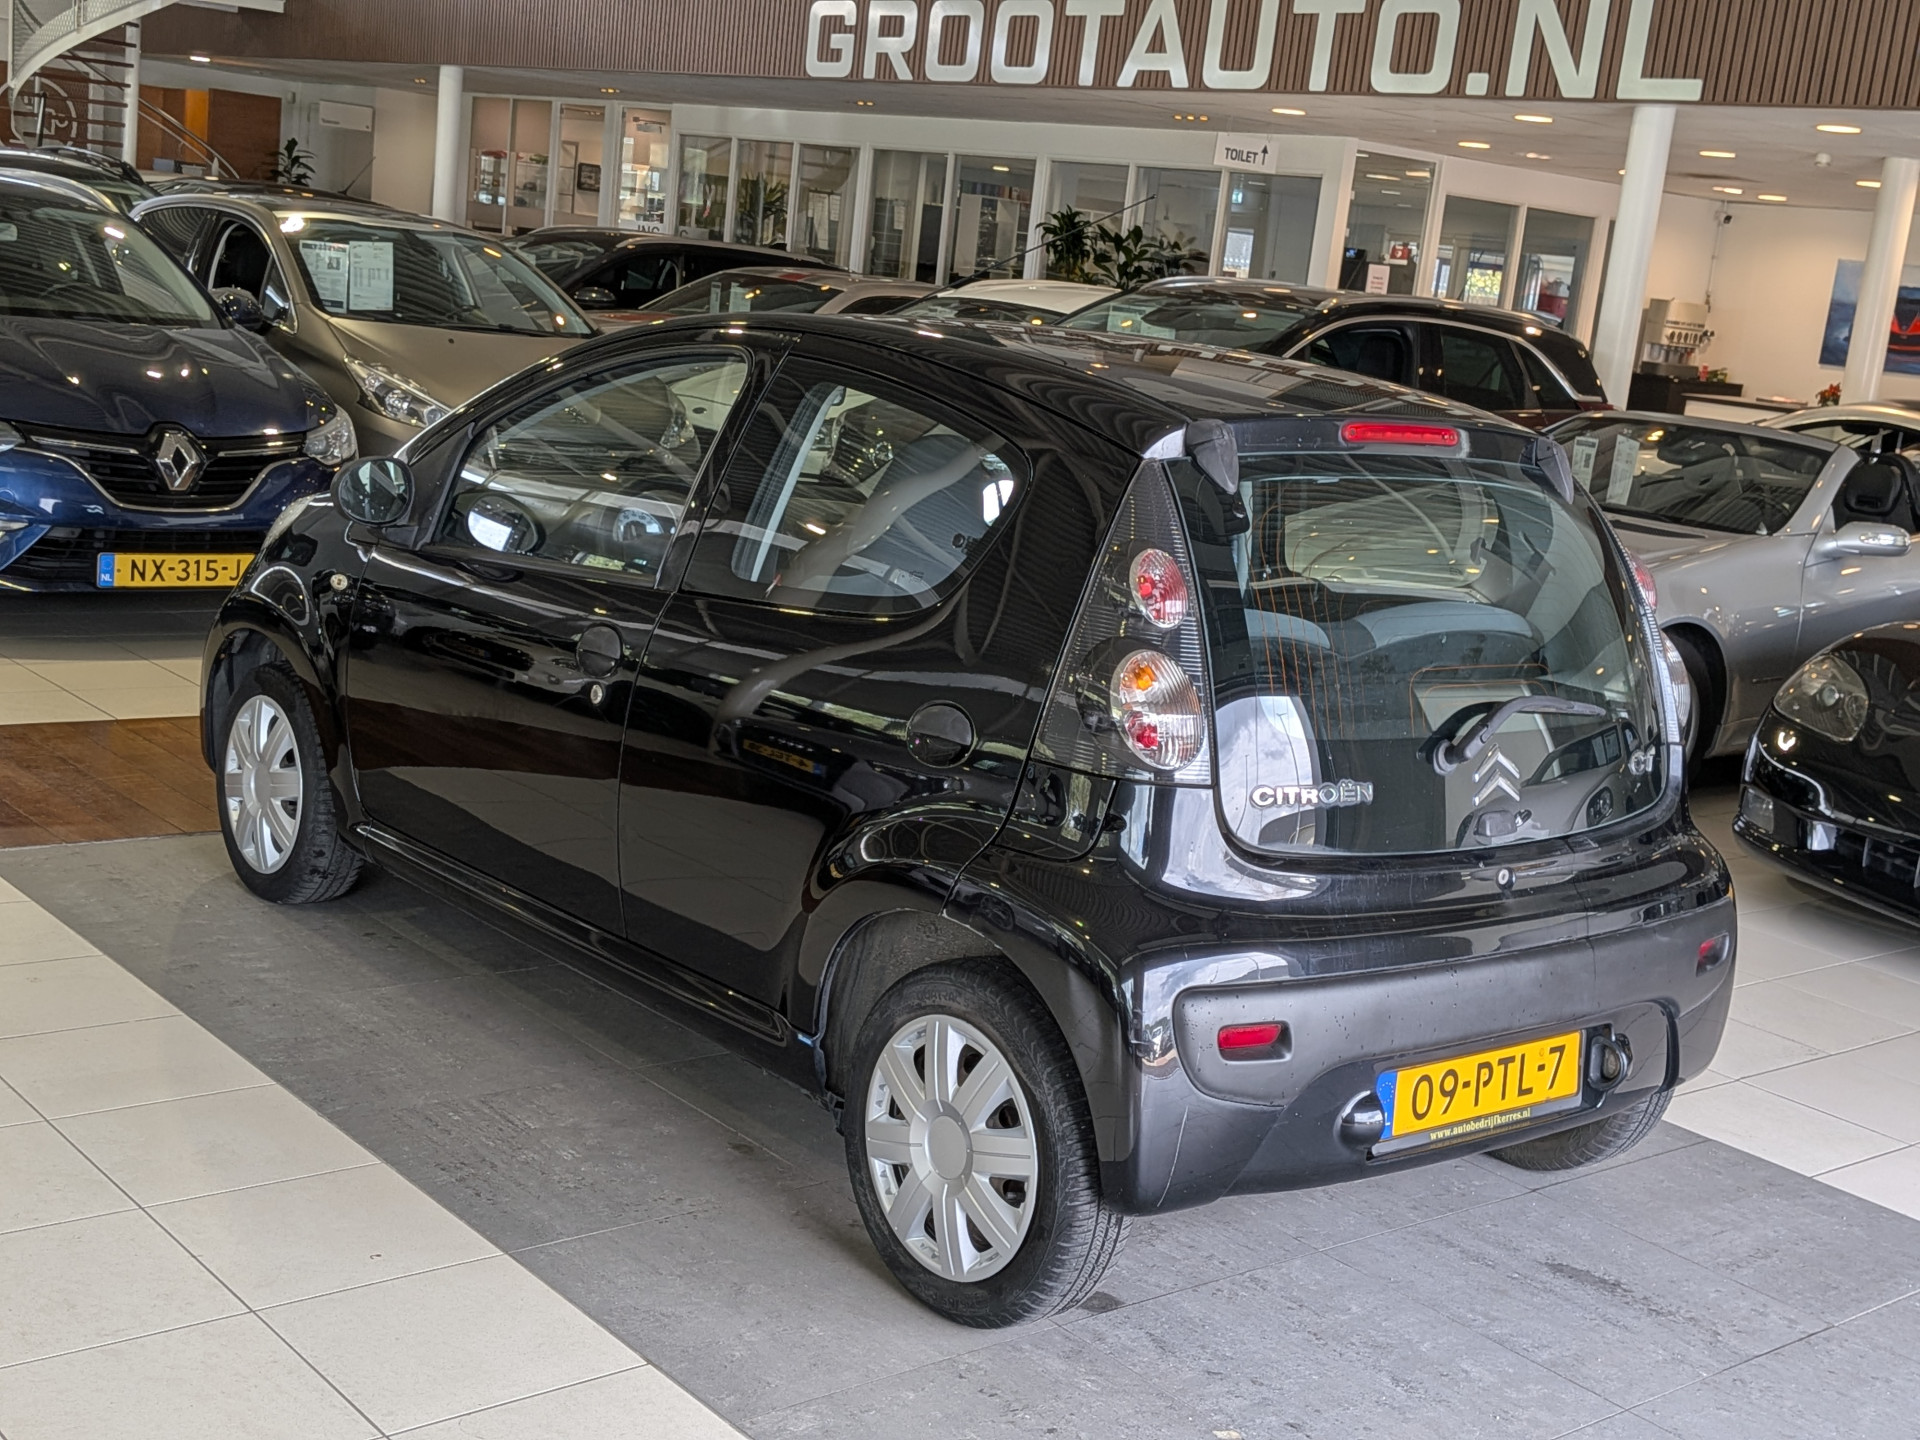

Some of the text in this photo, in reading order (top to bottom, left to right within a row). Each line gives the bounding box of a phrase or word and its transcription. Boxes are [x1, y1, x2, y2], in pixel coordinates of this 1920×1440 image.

[805, 0, 1703, 101] GROOTAUTO.NL
[1224, 147, 1259, 164] TOILET
[100, 573, 113, 582] NL
[130, 559, 242, 582] NX-315-J
[1250, 779, 1374, 811] CITROËN
[1411, 1044, 1567, 1121] 09-PTL-7
